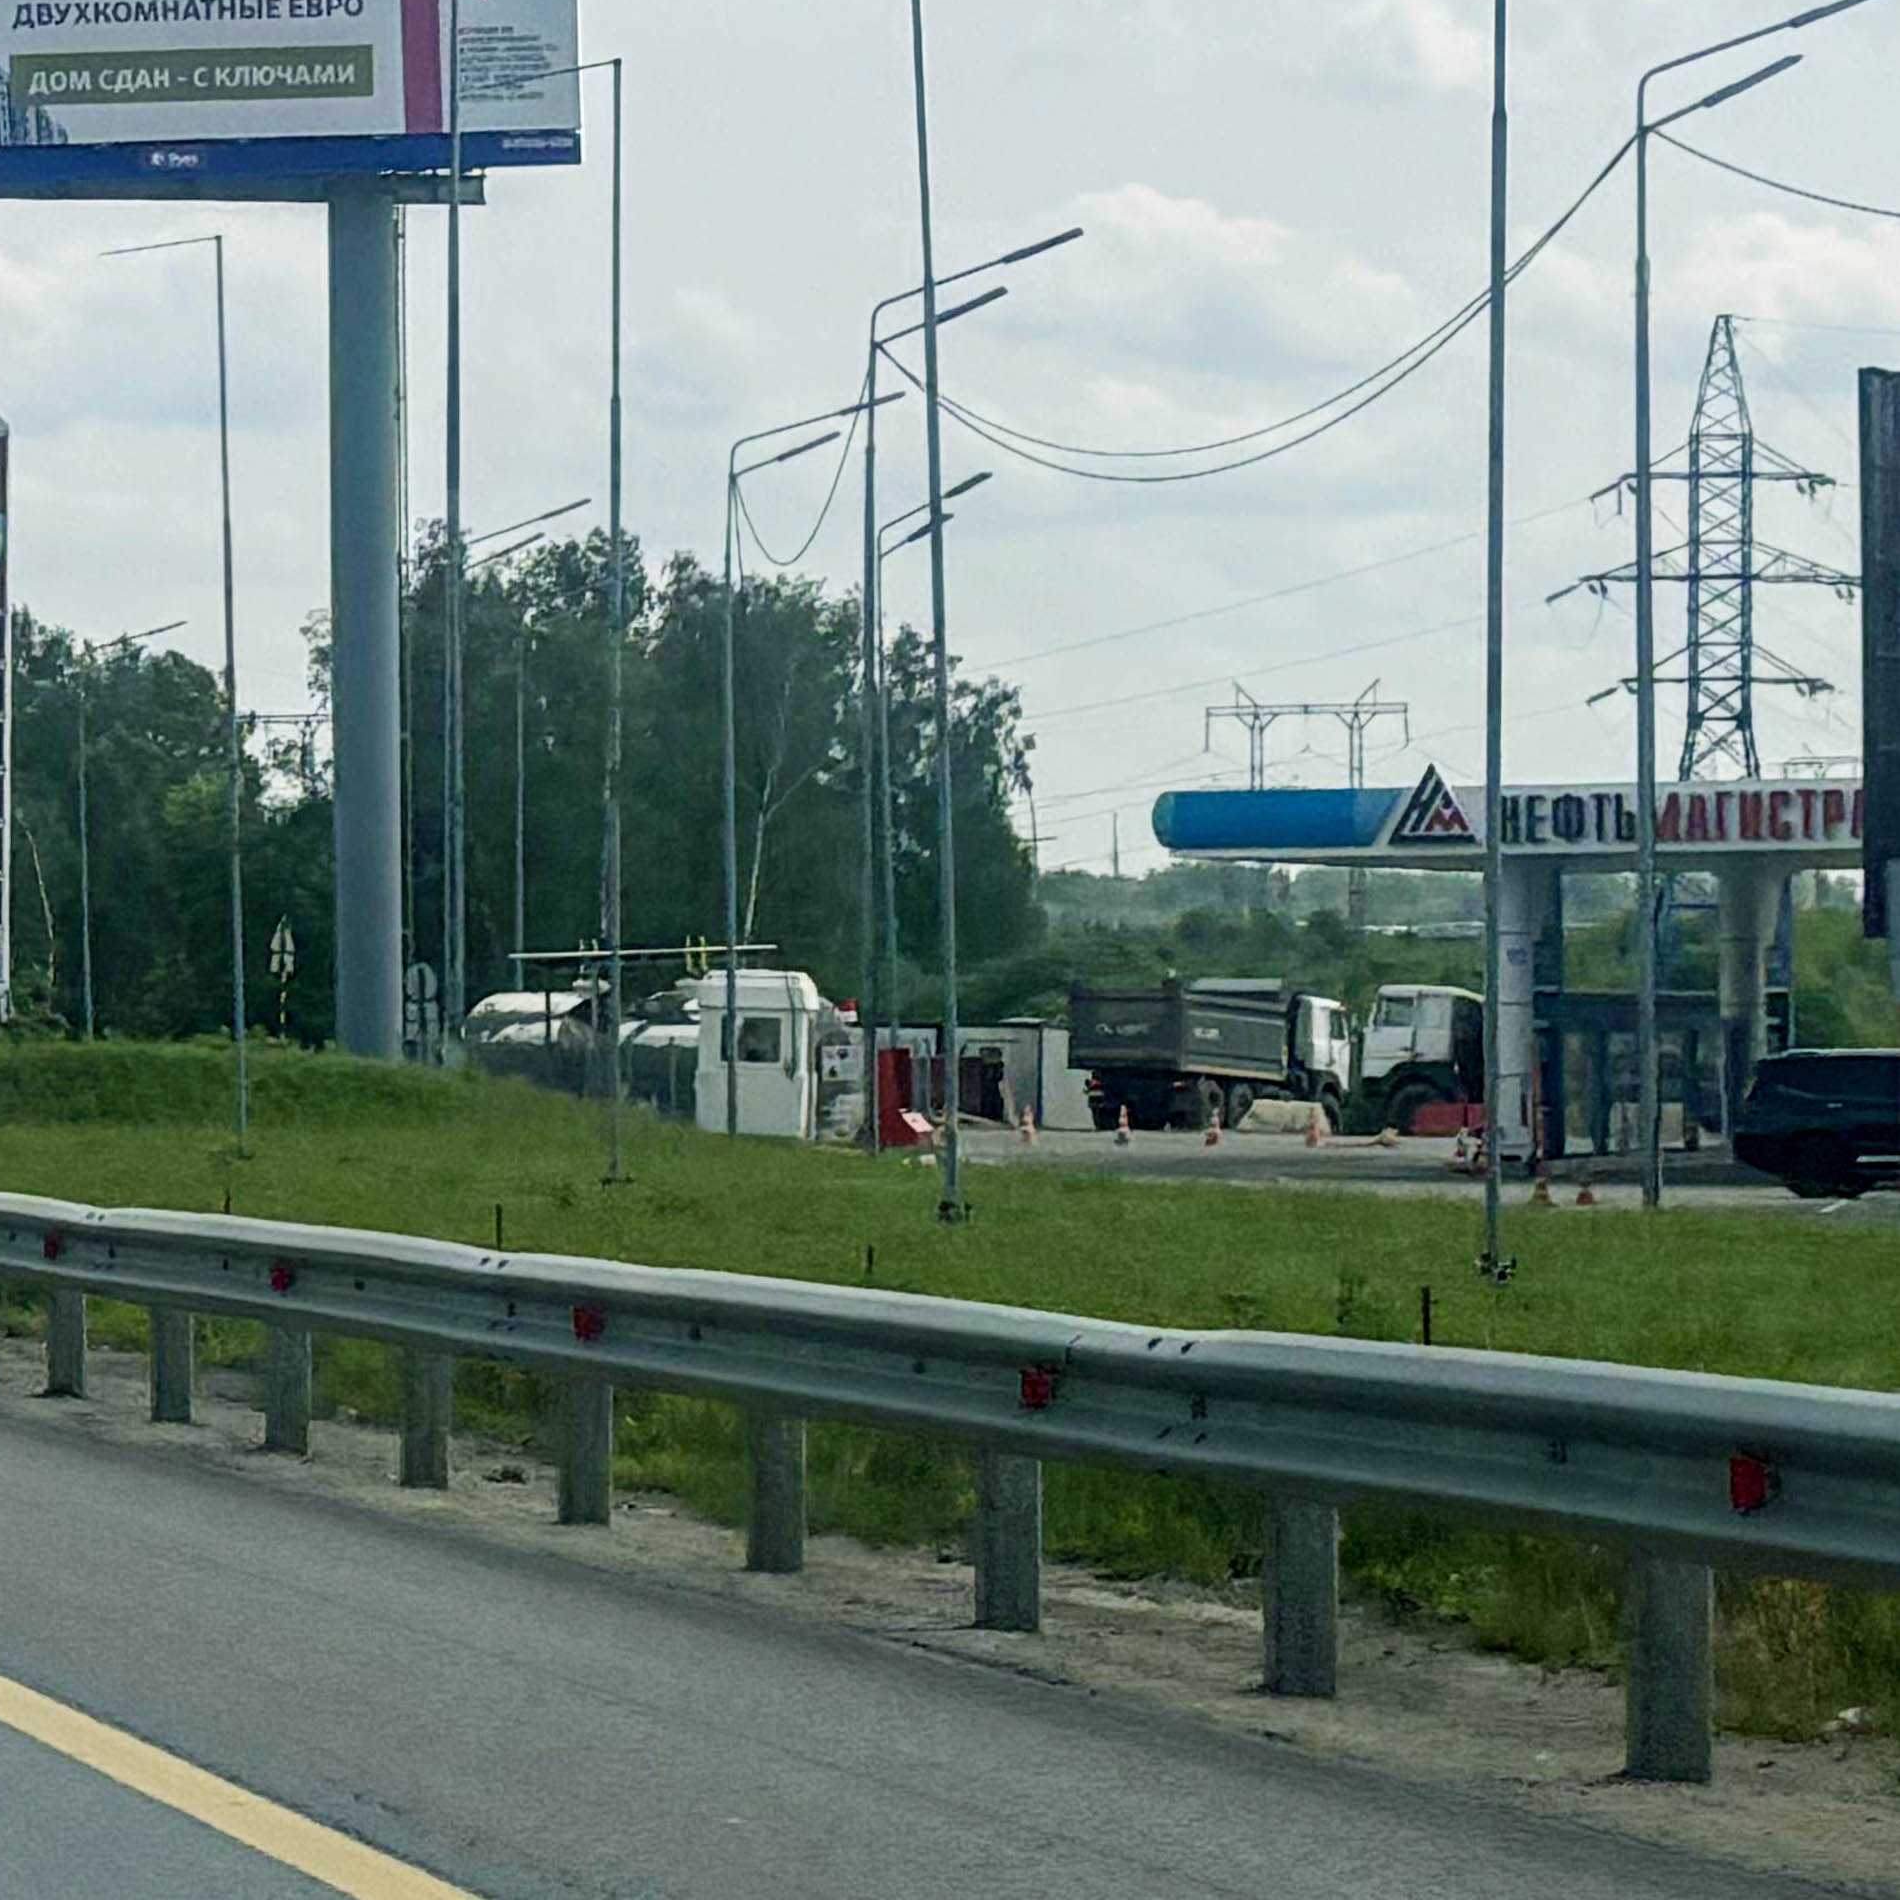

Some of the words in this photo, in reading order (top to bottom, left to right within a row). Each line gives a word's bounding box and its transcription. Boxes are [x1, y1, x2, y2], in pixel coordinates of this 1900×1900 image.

[28, 70, 91, 95] ДОМ
[99, 67, 169, 94] СДАН
[194, 67, 209, 87] С
[215, 63, 355, 89] КЛЮЧАМИ
[1501, 793, 1636, 843] НЕФТЬ
